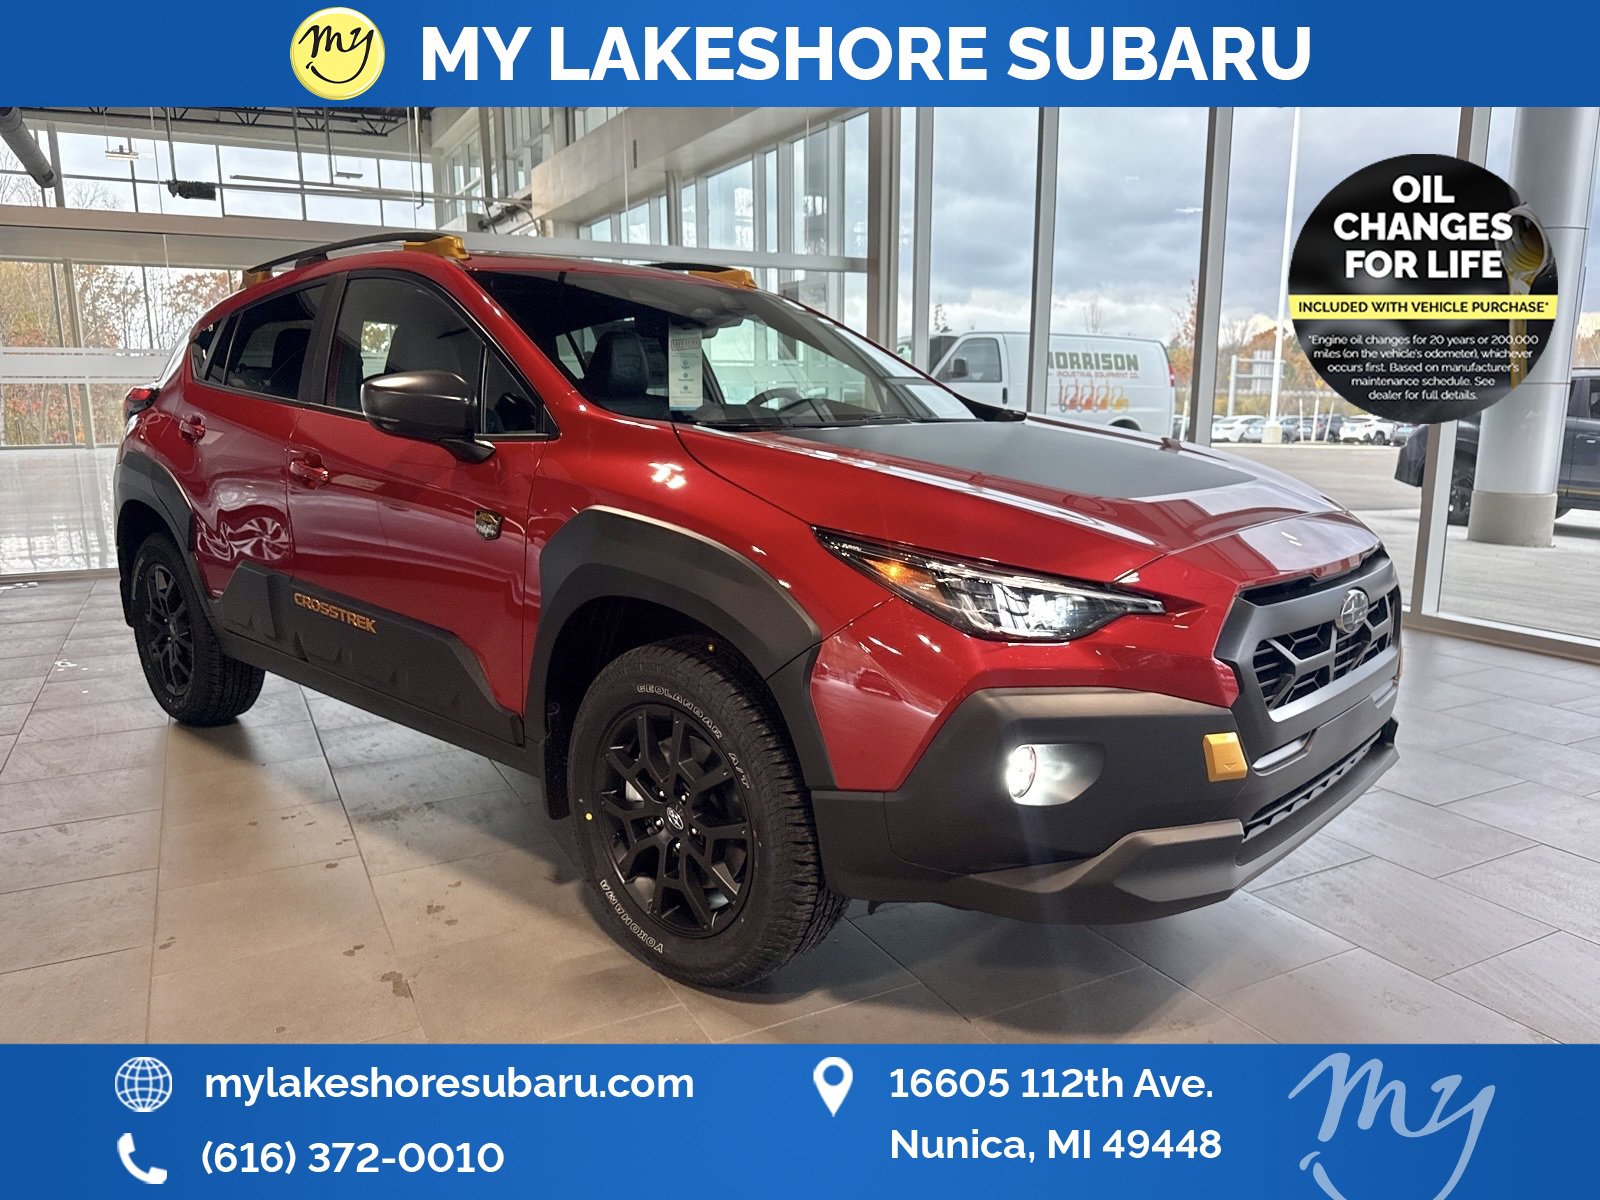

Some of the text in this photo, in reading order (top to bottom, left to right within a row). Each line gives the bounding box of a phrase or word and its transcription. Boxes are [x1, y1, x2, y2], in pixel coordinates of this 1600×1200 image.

[293, 592, 377, 635] CROSSTREK
[636, 683, 750, 789] GEOLANDAR A/T
[600, 879, 664, 954] YOKOHAMA
